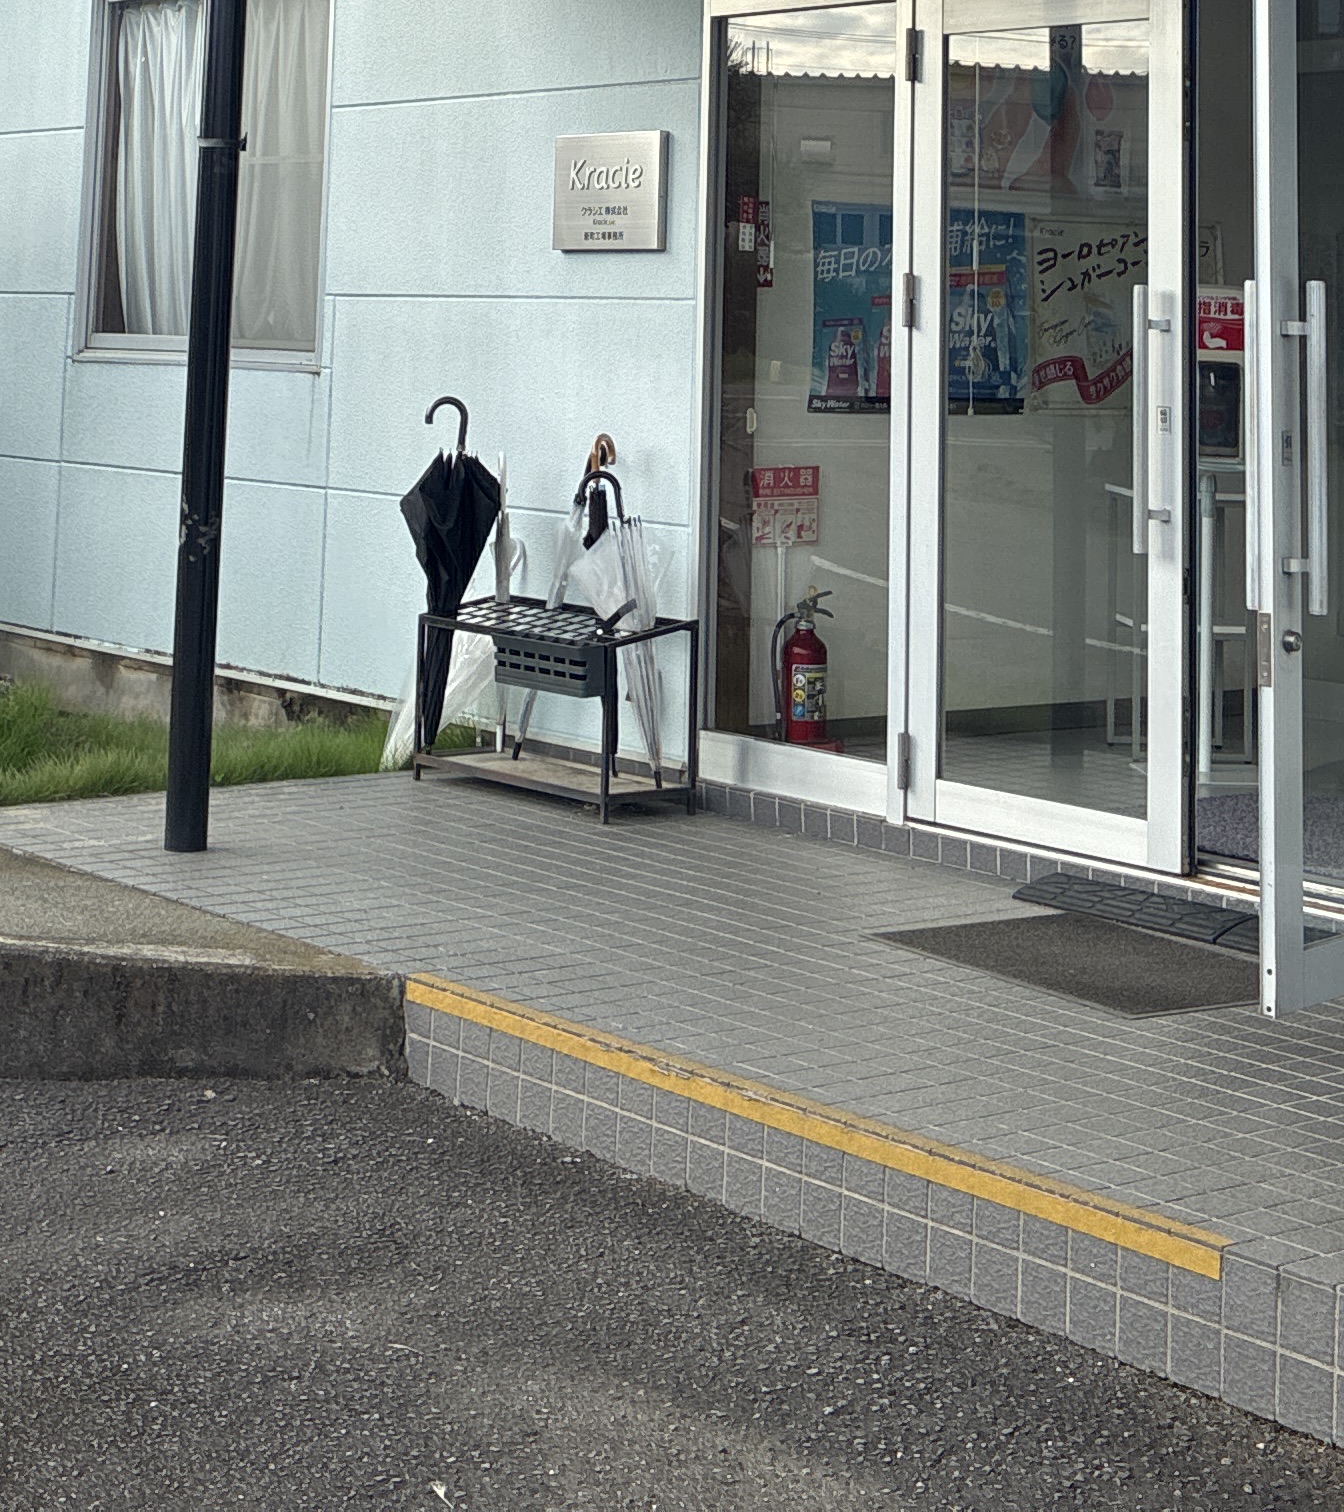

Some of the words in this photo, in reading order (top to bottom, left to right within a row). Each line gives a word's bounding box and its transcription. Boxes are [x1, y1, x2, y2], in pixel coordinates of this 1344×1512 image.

[569, 158, 644, 190] Kracie
[1040, 249, 1148, 302] シュガーコー
[950, 307, 993, 336] Sky
[830, 342, 855, 359] Sky
[759, 468, 813, 488] 消火器
